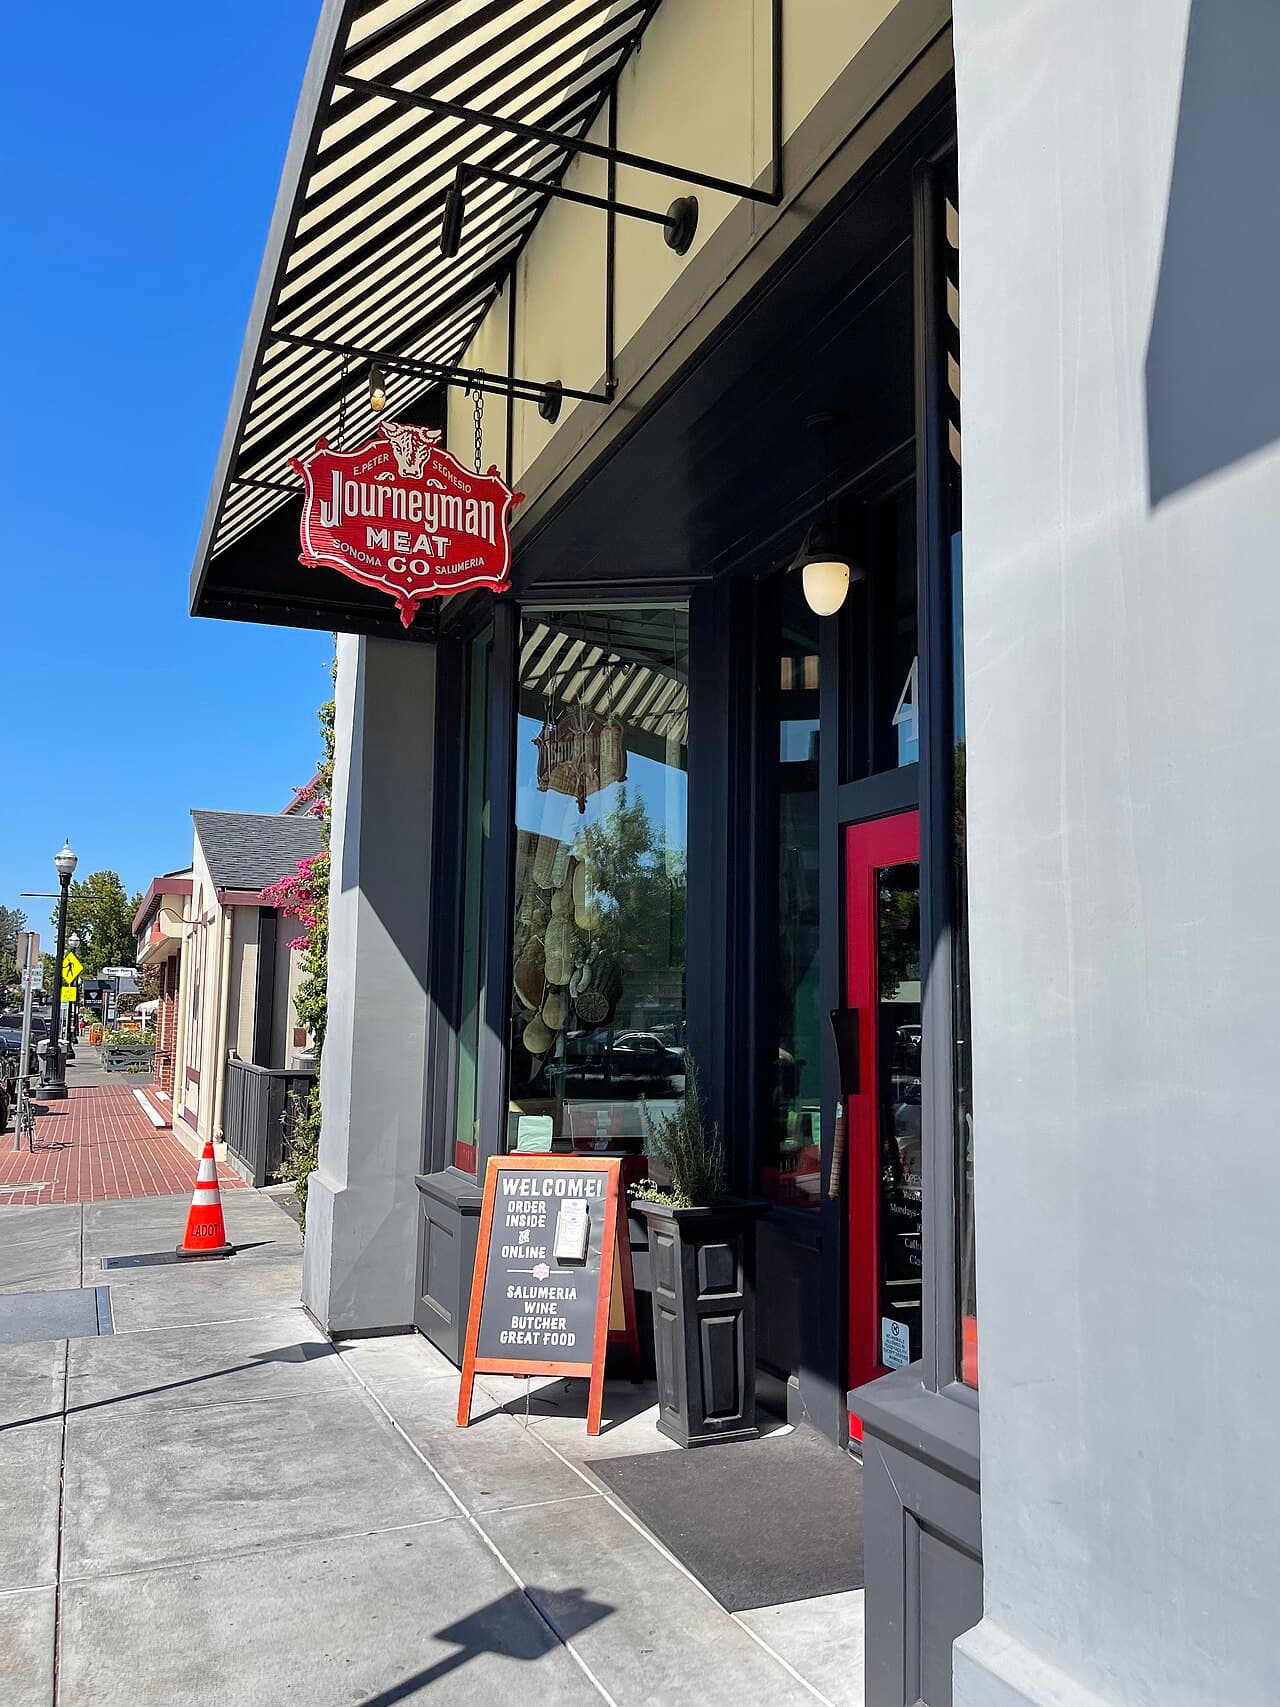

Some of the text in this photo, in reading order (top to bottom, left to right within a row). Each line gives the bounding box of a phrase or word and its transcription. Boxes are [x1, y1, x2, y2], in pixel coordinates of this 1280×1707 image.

[432, 460, 472, 493] SEGHESIO
[319, 470, 496, 546] Journeyman
[366, 526, 451, 558] MEAT
[332, 539, 382, 567] SONOMA
[387, 556, 430, 576] CO
[434, 557, 485, 575] SALUMERIA
[502, 1178, 602, 1197] WELCOME!
[507, 1201, 546, 1214] ORDER
[506, 1215, 546, 1228] INSIDE
[191, 1224, 218, 1237] LADOT
[501, 1246, 546, 1259] ONLINE
[506, 1286, 577, 1300] SALUMERIA
[524, 1302, 557, 1315] WINE
[511, 1317, 567, 1330] BUTCHER
[500, 1331, 576, 1347] GREAT FOOD
